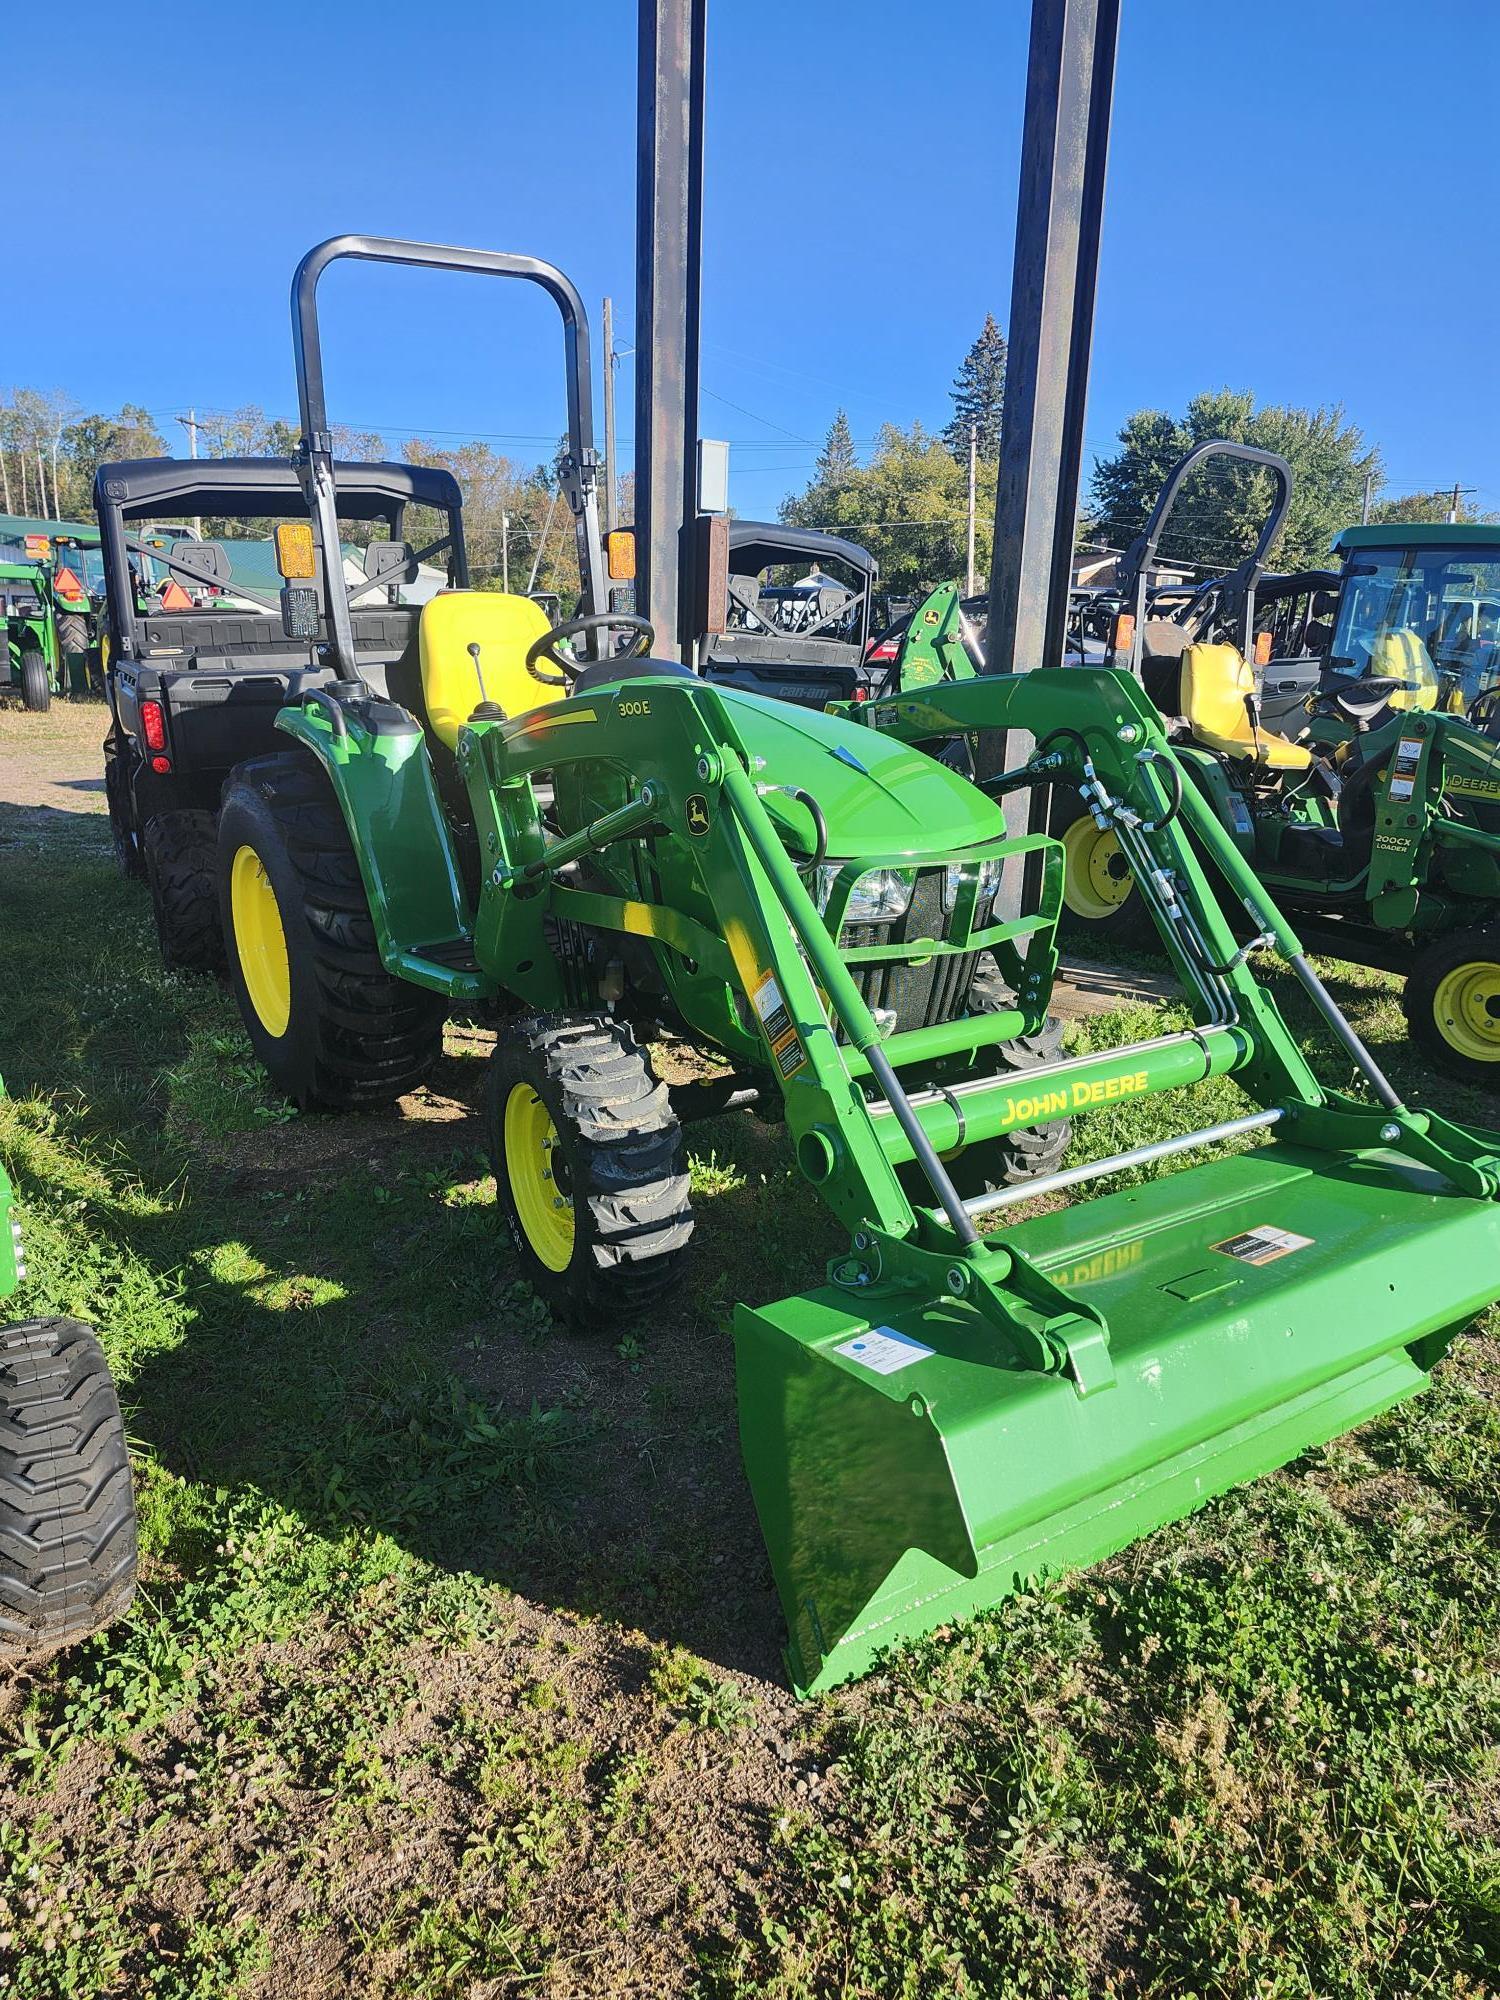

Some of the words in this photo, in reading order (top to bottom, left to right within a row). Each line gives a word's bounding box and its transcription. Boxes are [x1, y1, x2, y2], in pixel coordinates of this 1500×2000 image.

[1451, 774, 1498, 792] DEERE
[1375, 834, 1412, 846] 200CX
[1376, 842, 1408, 853] LOADER
[1001, 1090, 1068, 1125] JOHN
[1071, 1071, 1148, 1107] DEERE
